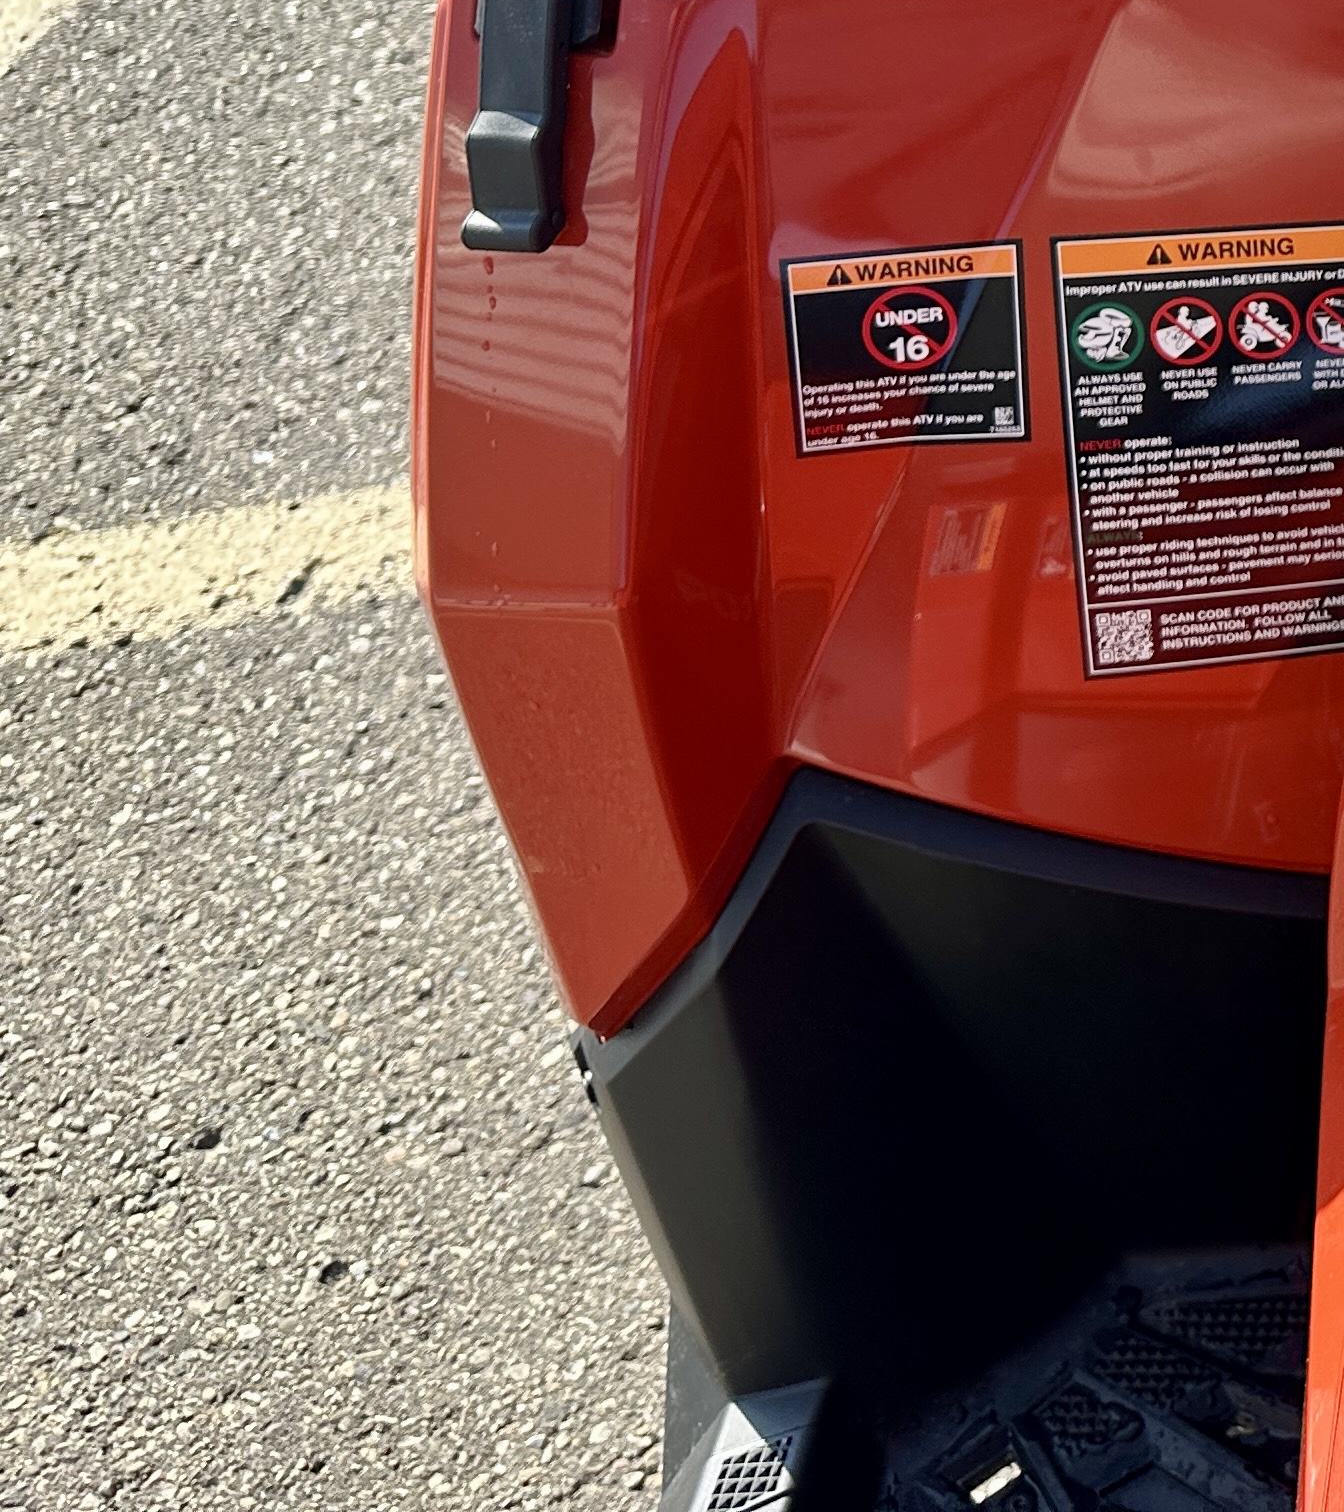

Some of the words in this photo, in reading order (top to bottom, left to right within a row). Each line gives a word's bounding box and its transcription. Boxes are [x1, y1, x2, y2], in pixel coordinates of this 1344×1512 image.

[1178, 237, 1294, 261] WARNING
[855, 255, 973, 281] WARNING
[1065, 284, 1117, 297] Improper
[1117, 281, 1142, 293] ATV
[1143, 281, 1165, 292] use
[1165, 279, 1187, 290] can
[1187, 276, 1220, 289] result
[1220, 275, 1232, 286] in
[1232, 272, 1279, 286] SEVERE
[1281, 270, 1323, 282] INJURY
[1323, 271, 1337, 281] or
[875, 306, 943, 327] UNDER
[888, 335, 929, 364] 16
[1088, 452, 1132, 465] without
[1134, 449, 1173, 463] proper
[1174, 445, 1220, 458] training
[1222, 444, 1235, 455] or
[1237, 439, 1300, 452] instruction
[1160, 611, 1195, 625] SCAN
[1196, 607, 1231, 621] CODE
[1234, 604, 1260, 617] FOR
[1262, 597, 1321, 614] PRODUCT
